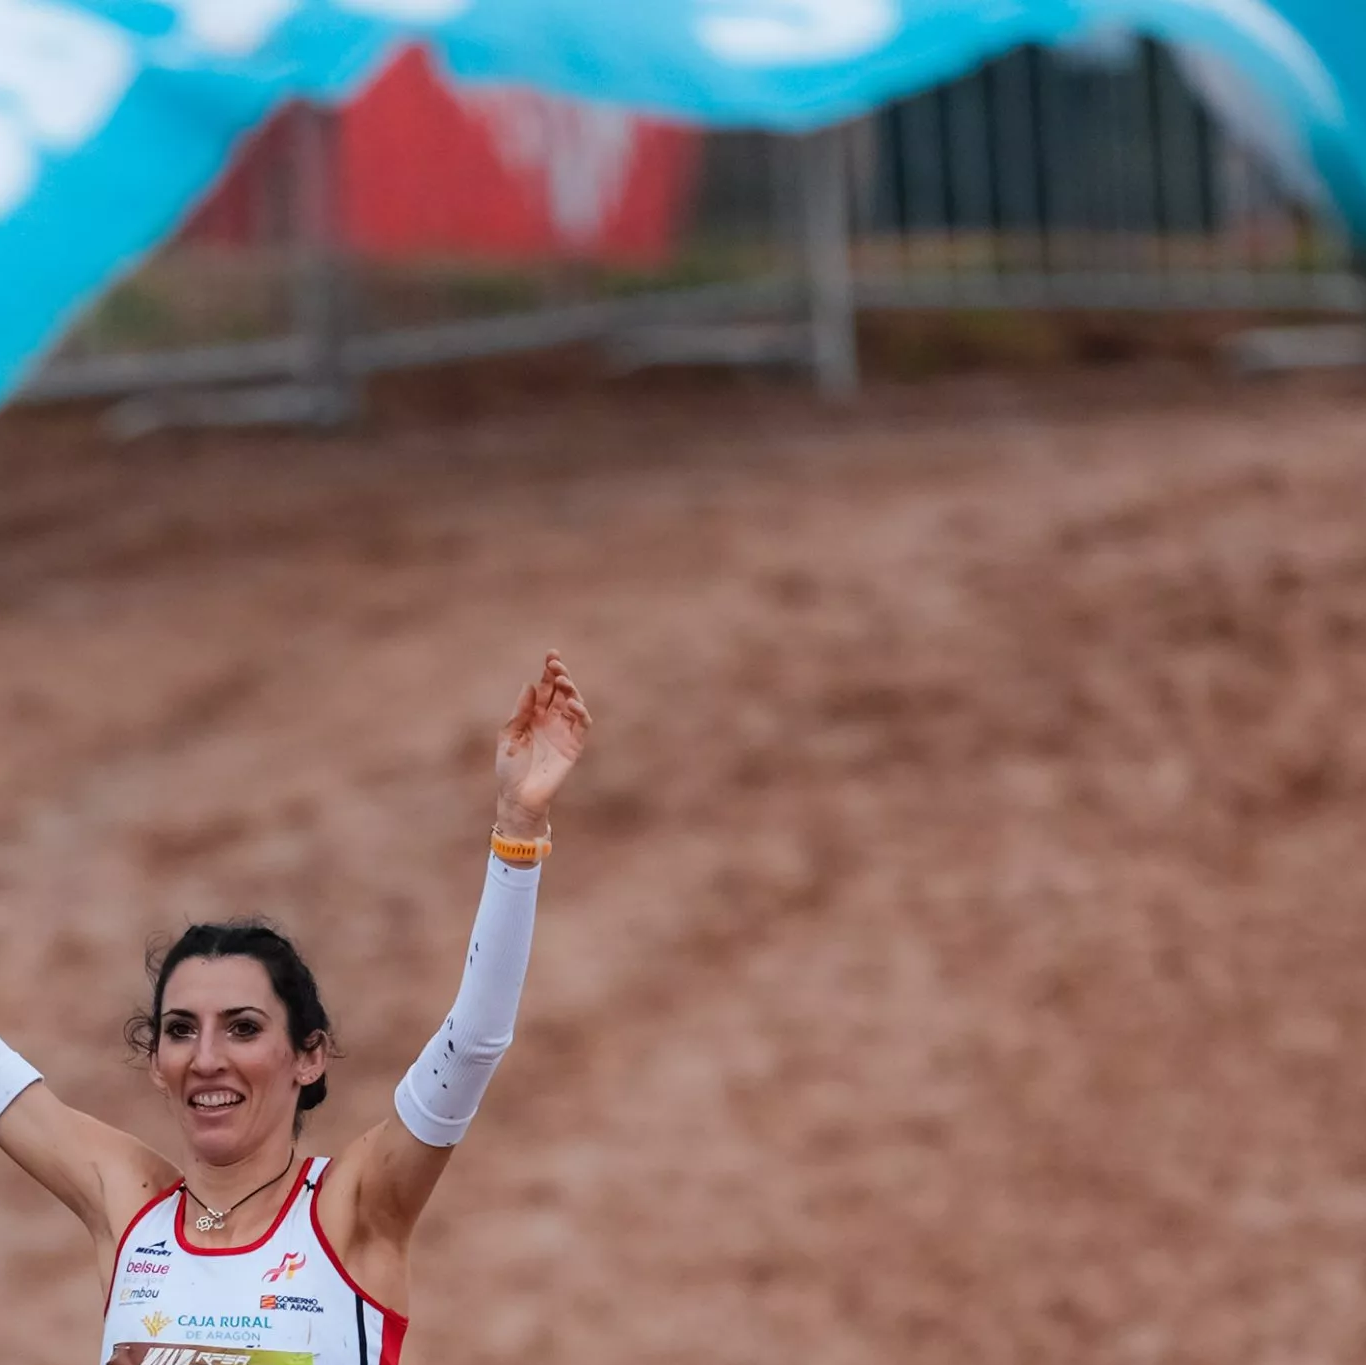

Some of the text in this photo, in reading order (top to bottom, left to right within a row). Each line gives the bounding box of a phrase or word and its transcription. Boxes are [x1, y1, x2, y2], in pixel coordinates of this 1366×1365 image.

[276, 1295, 318, 1306] GOBIERNO
[276, 1303, 287, 1311] DE
[177, 1314, 273, 1329] CAJA RURAL
[185, 1330, 261, 1342] DE ARAGÓN
